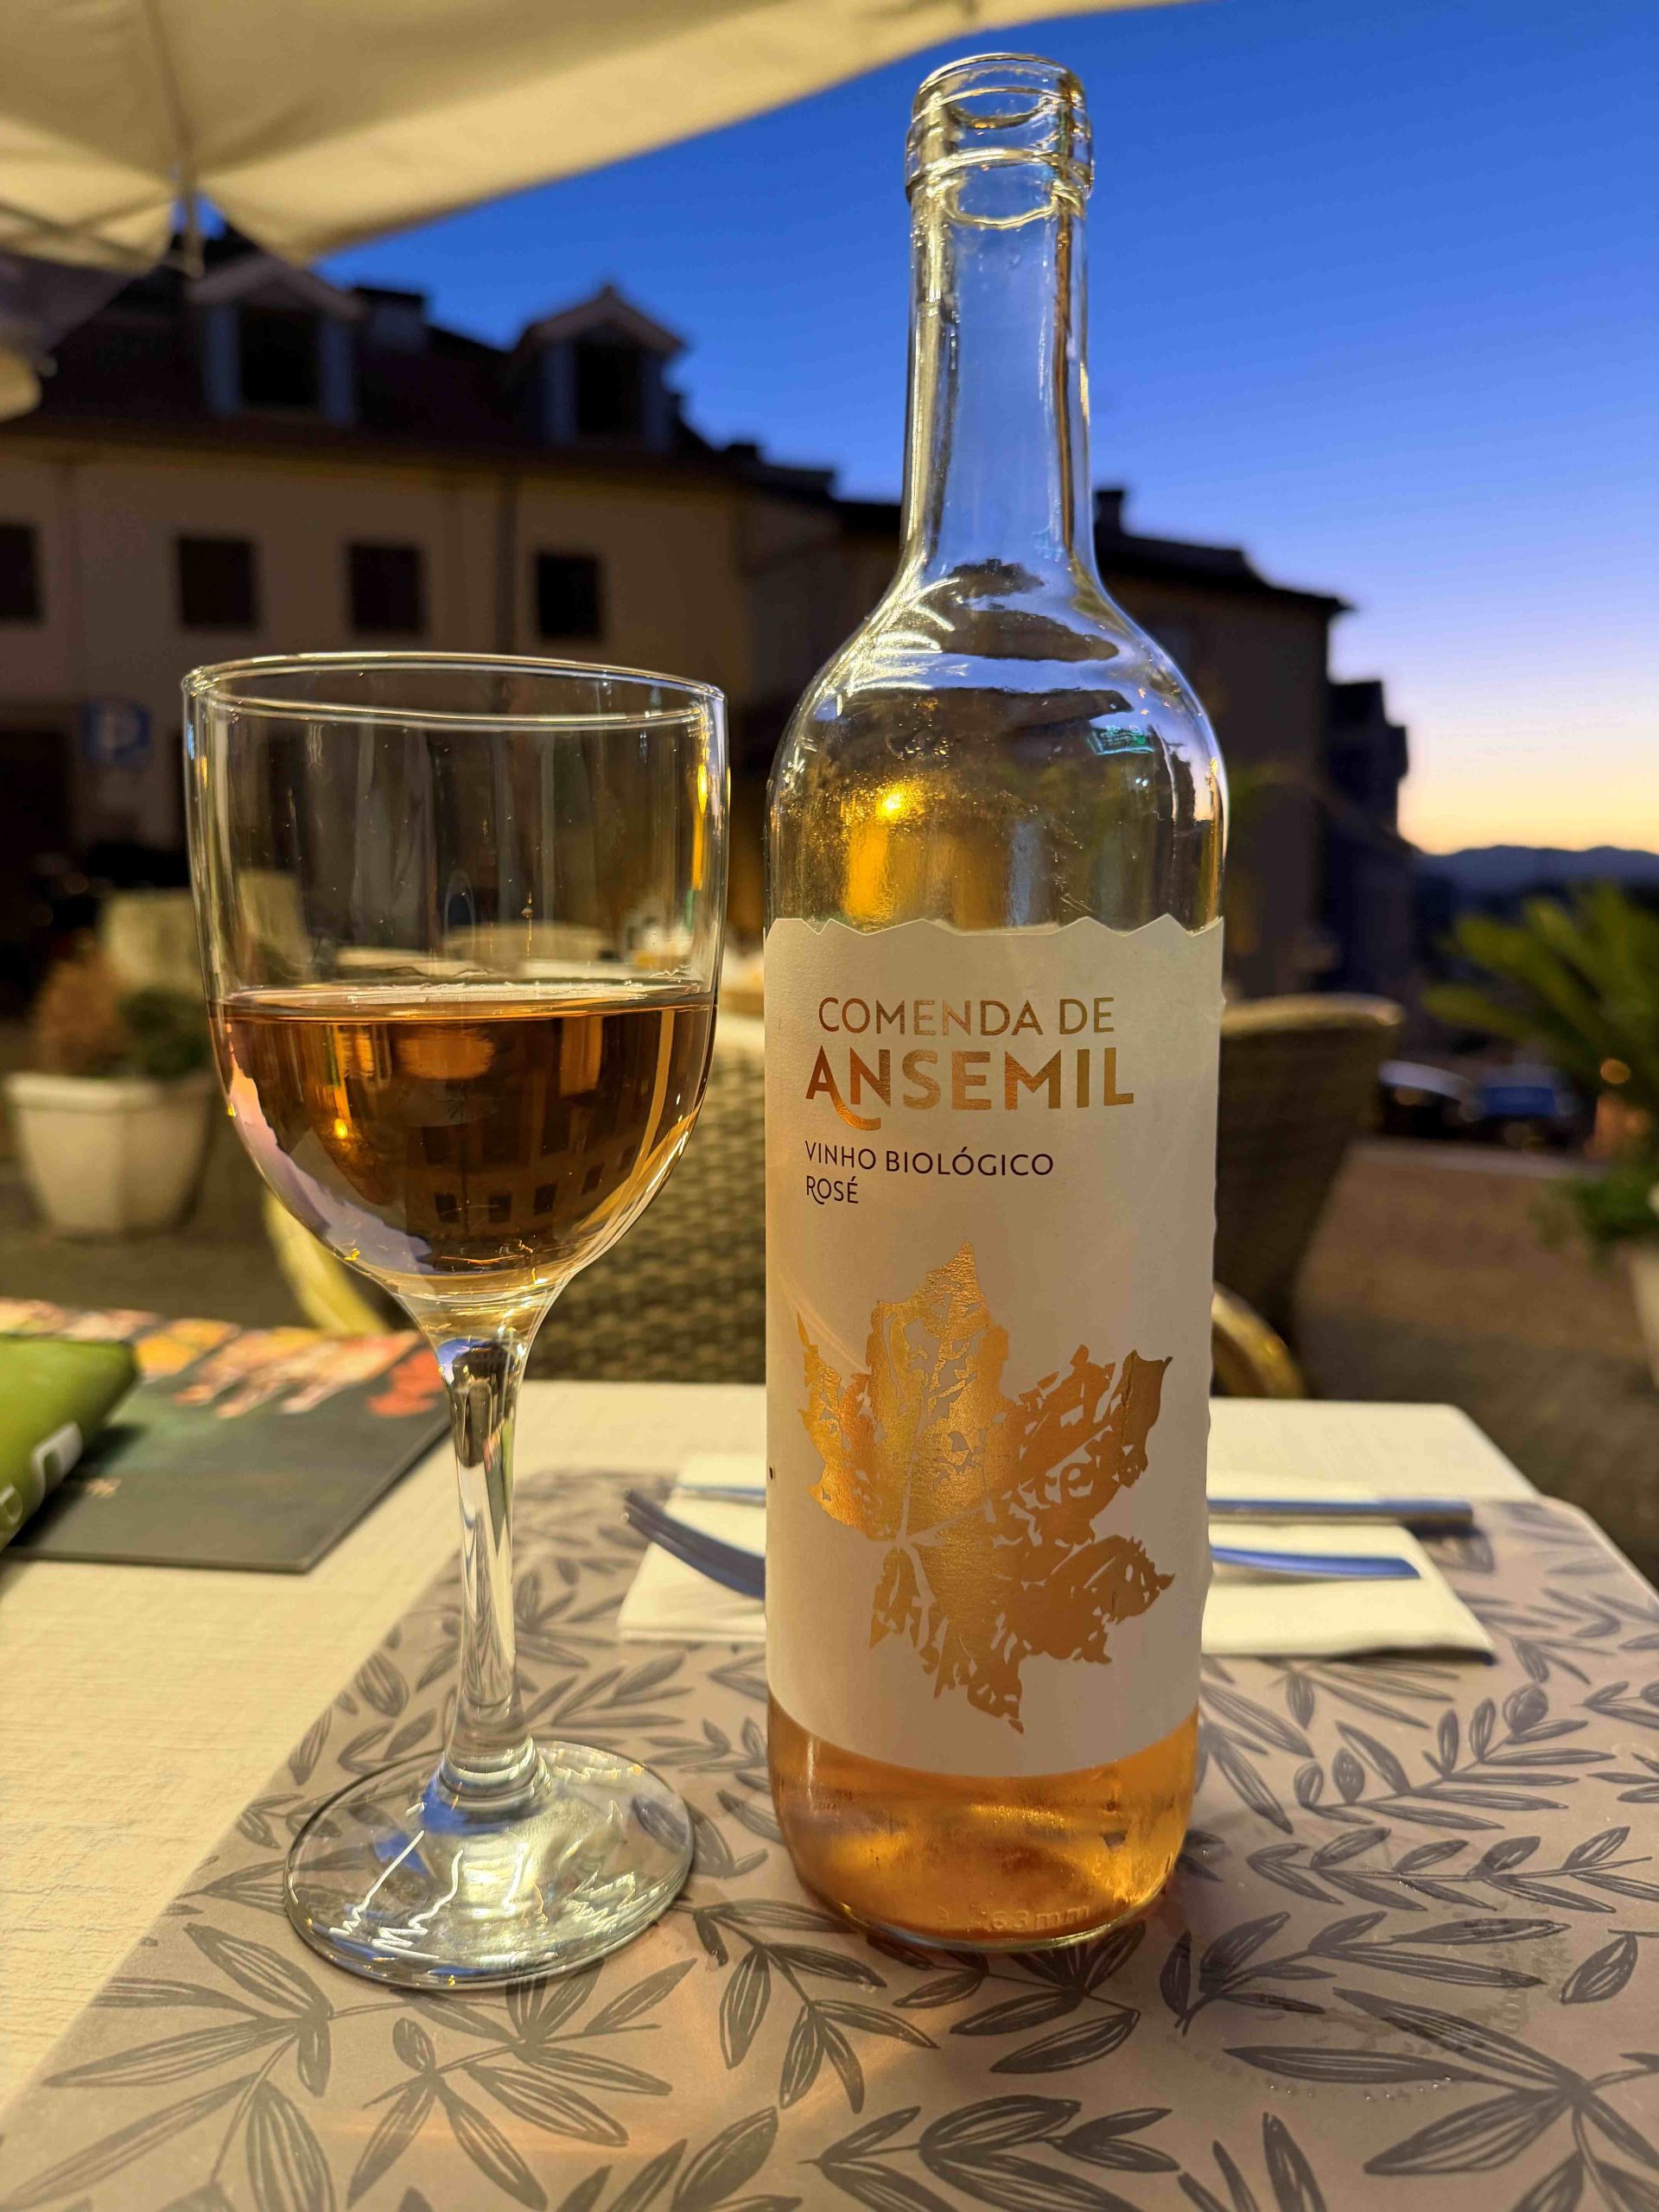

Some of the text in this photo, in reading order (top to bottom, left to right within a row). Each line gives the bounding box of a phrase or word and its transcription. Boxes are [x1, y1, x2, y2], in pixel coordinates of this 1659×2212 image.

[98, 707, 140, 759] P
[818, 996, 1115, 1036] COMENDA DE
[805, 1045, 1135, 1131] ANSEMIL
[804, 1140, 1054, 1176] VINHO BIOLÓGICO
[805, 1174, 859, 1205] ROSÉ
